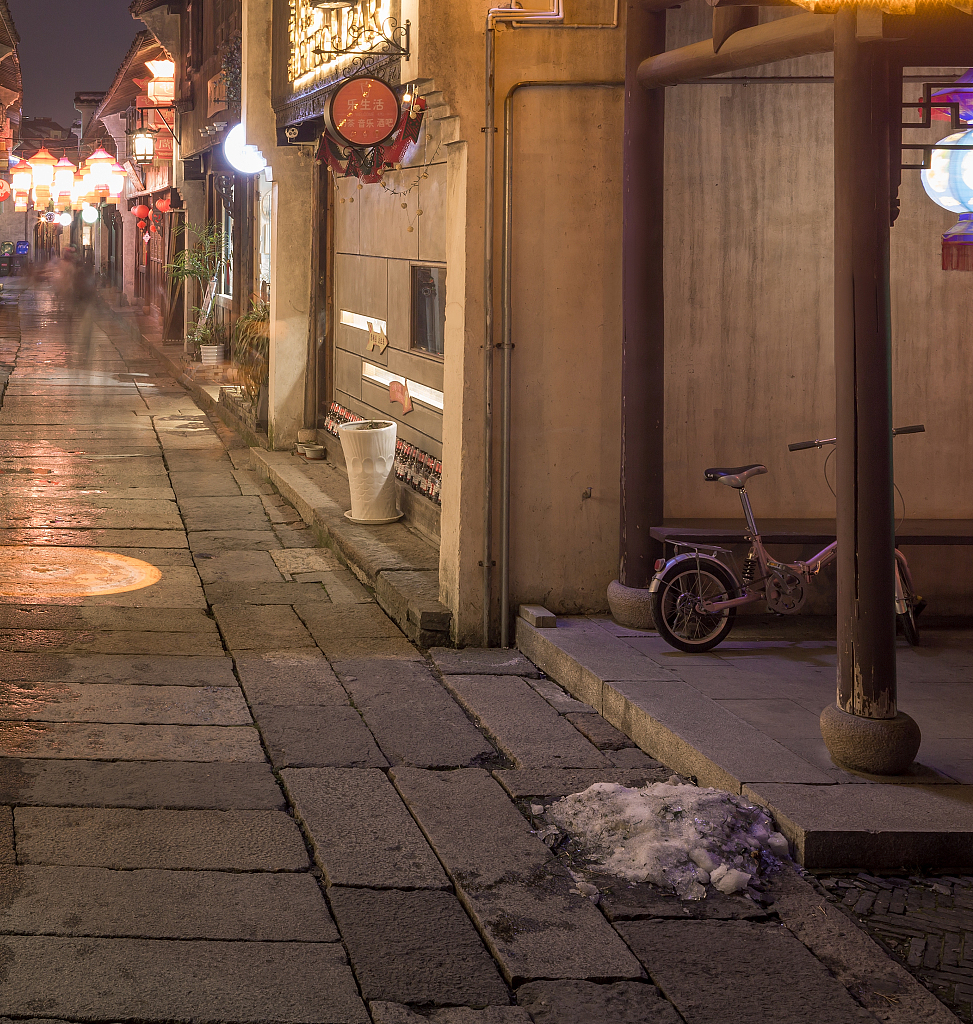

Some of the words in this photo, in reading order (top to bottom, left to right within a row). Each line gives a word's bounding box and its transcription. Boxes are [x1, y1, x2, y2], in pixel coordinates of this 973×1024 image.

[347, 99, 384, 111] 乐生活
[357, 118, 375, 128] 音乐
[376, 118, 394, 128] 酒吧
